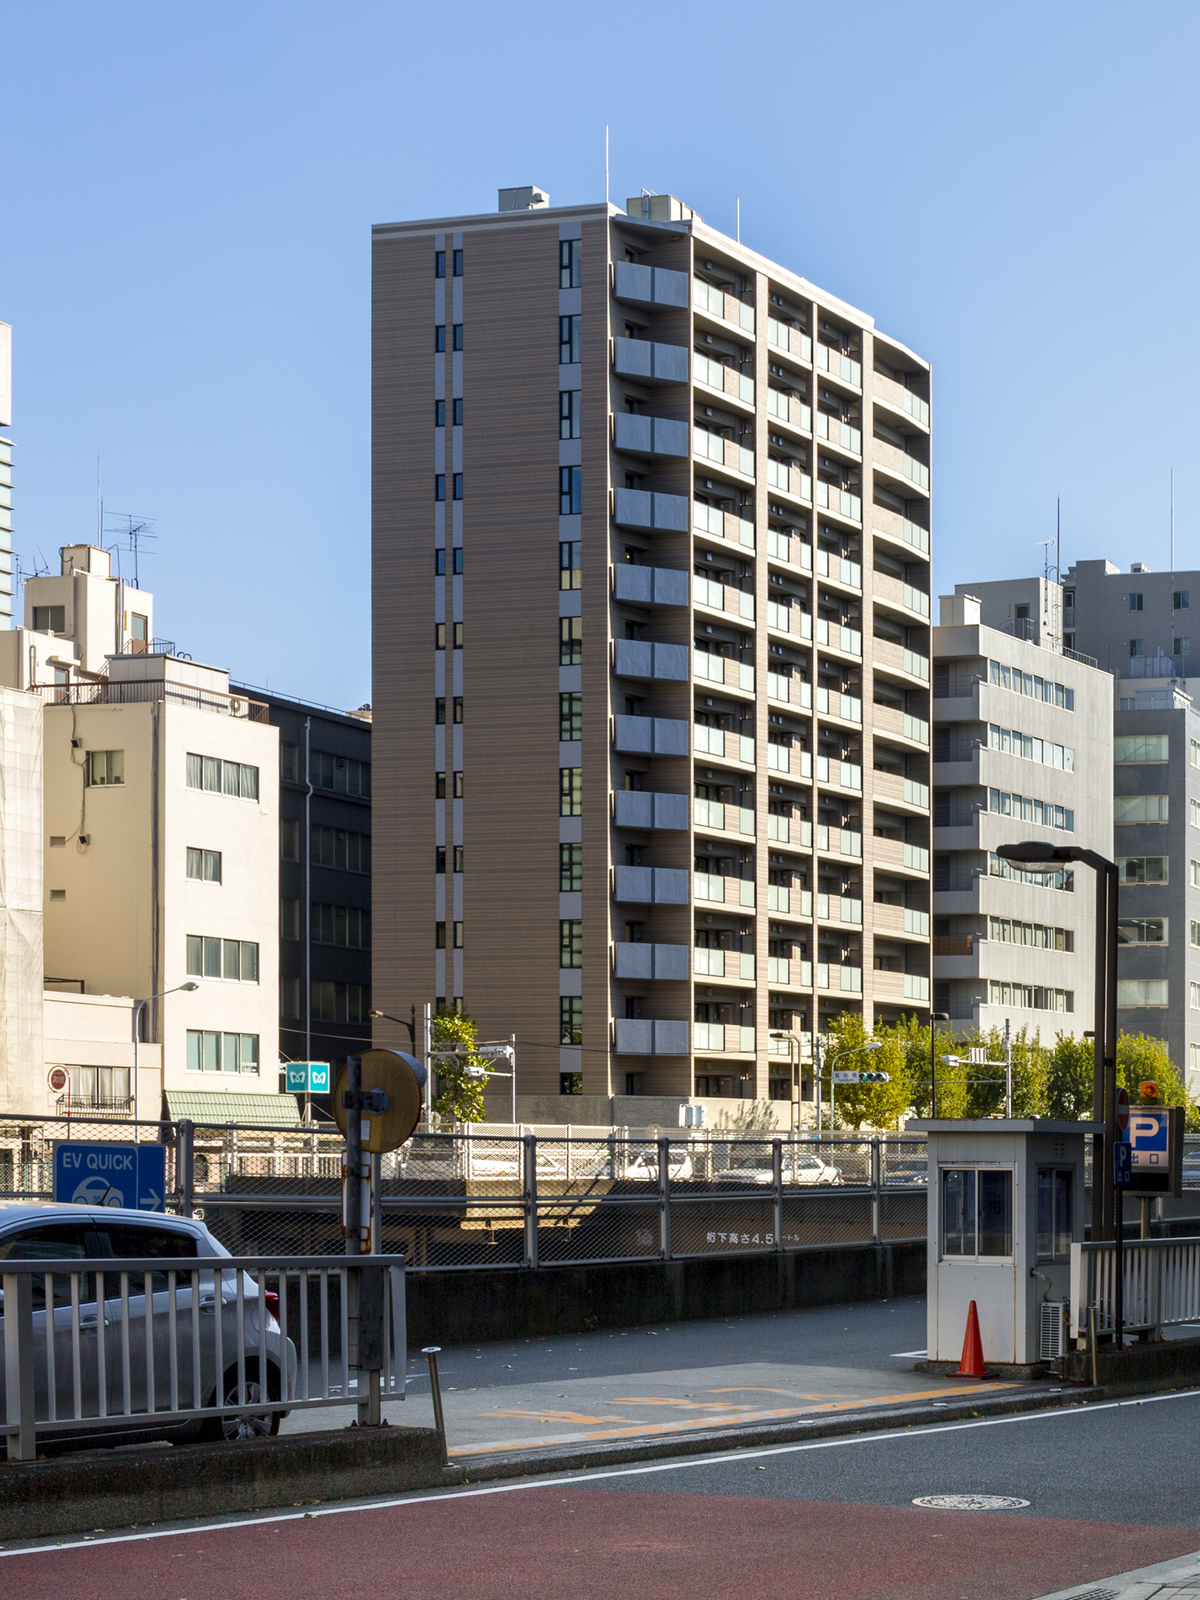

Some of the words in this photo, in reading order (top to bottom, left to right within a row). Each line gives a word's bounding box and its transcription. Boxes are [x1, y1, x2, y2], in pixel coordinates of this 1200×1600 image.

[1129, 1116, 1160, 1148] P
[62, 1152, 83, 1169] EV
[86, 1153, 133, 1171] QUICK
[1120, 1146, 1127, 1167] P
[706, 1231, 800, 1244] 桁下高さ4.5ートル
